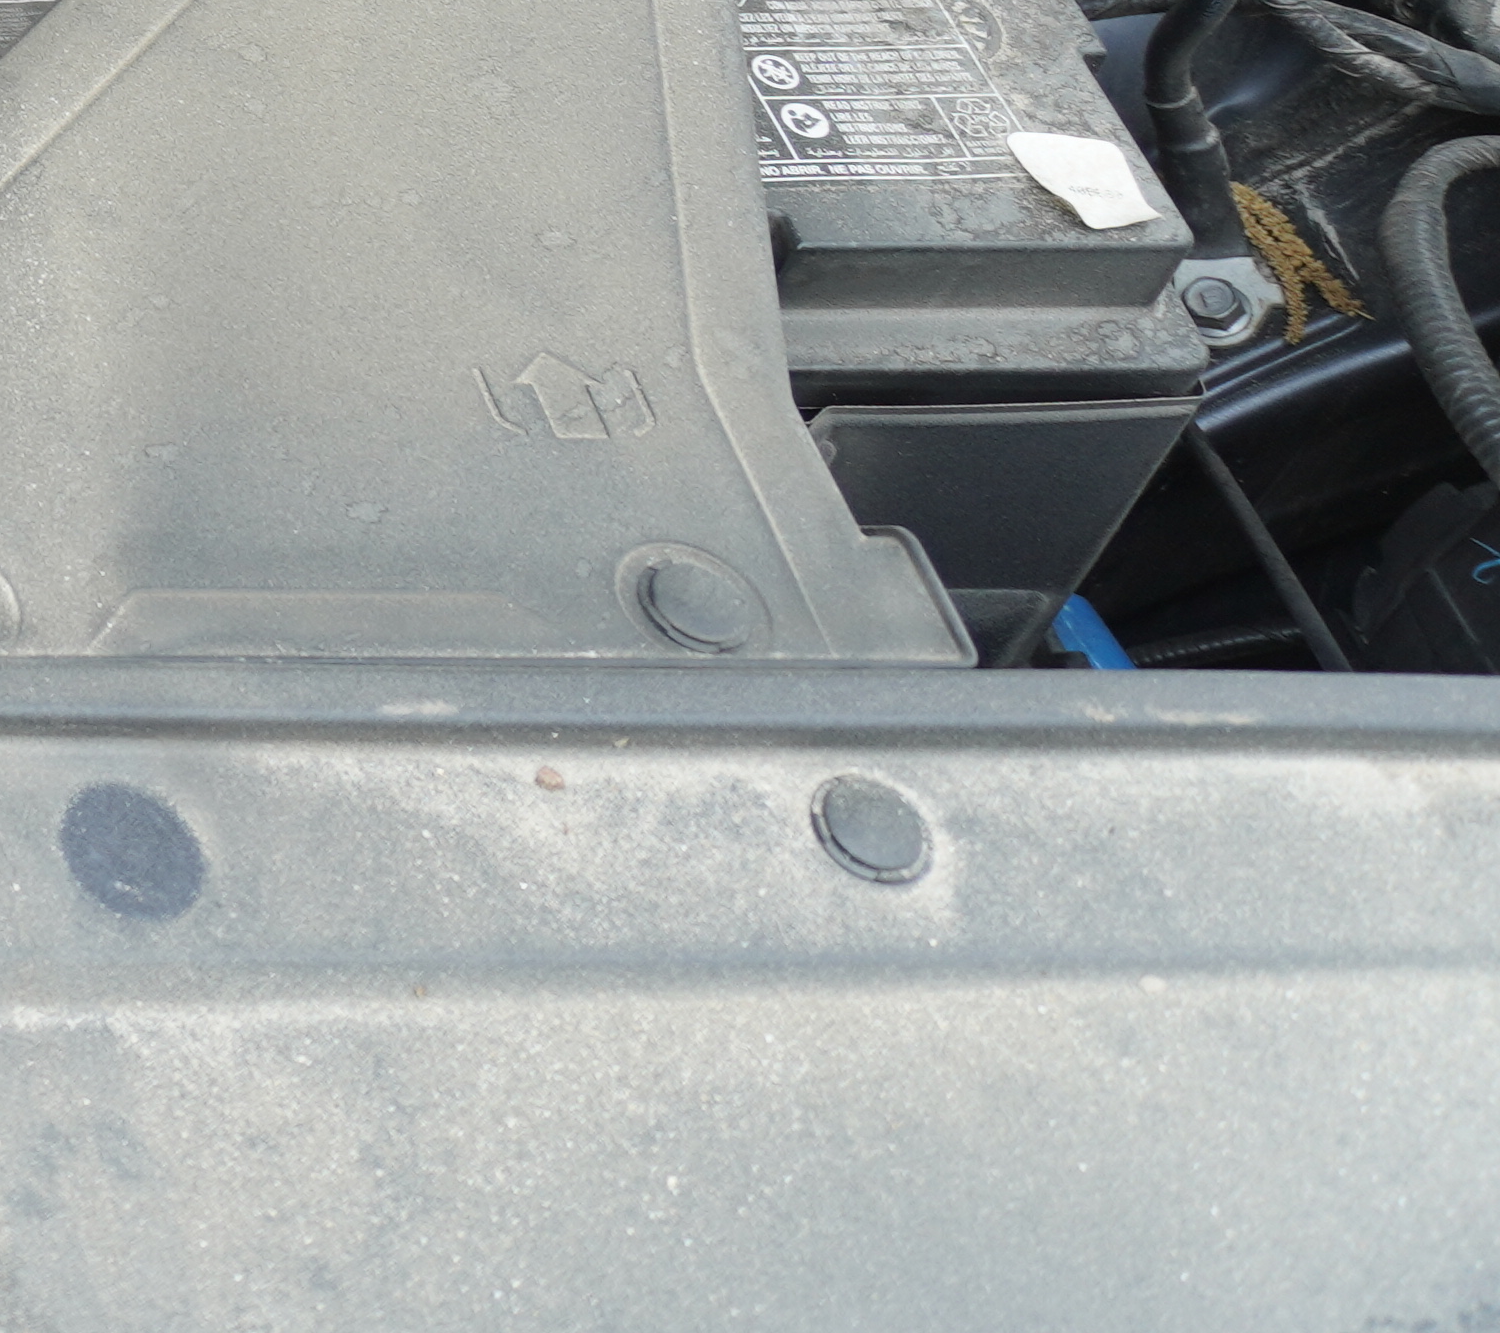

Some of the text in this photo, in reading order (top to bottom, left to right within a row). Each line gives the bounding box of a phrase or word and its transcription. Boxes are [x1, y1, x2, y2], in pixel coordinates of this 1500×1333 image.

[760, 166, 779, 176] NO
[782, 165, 825, 175] ABRIR.
[828, 165, 848, 174] NE
[850, 165, 873, 174] PAS
